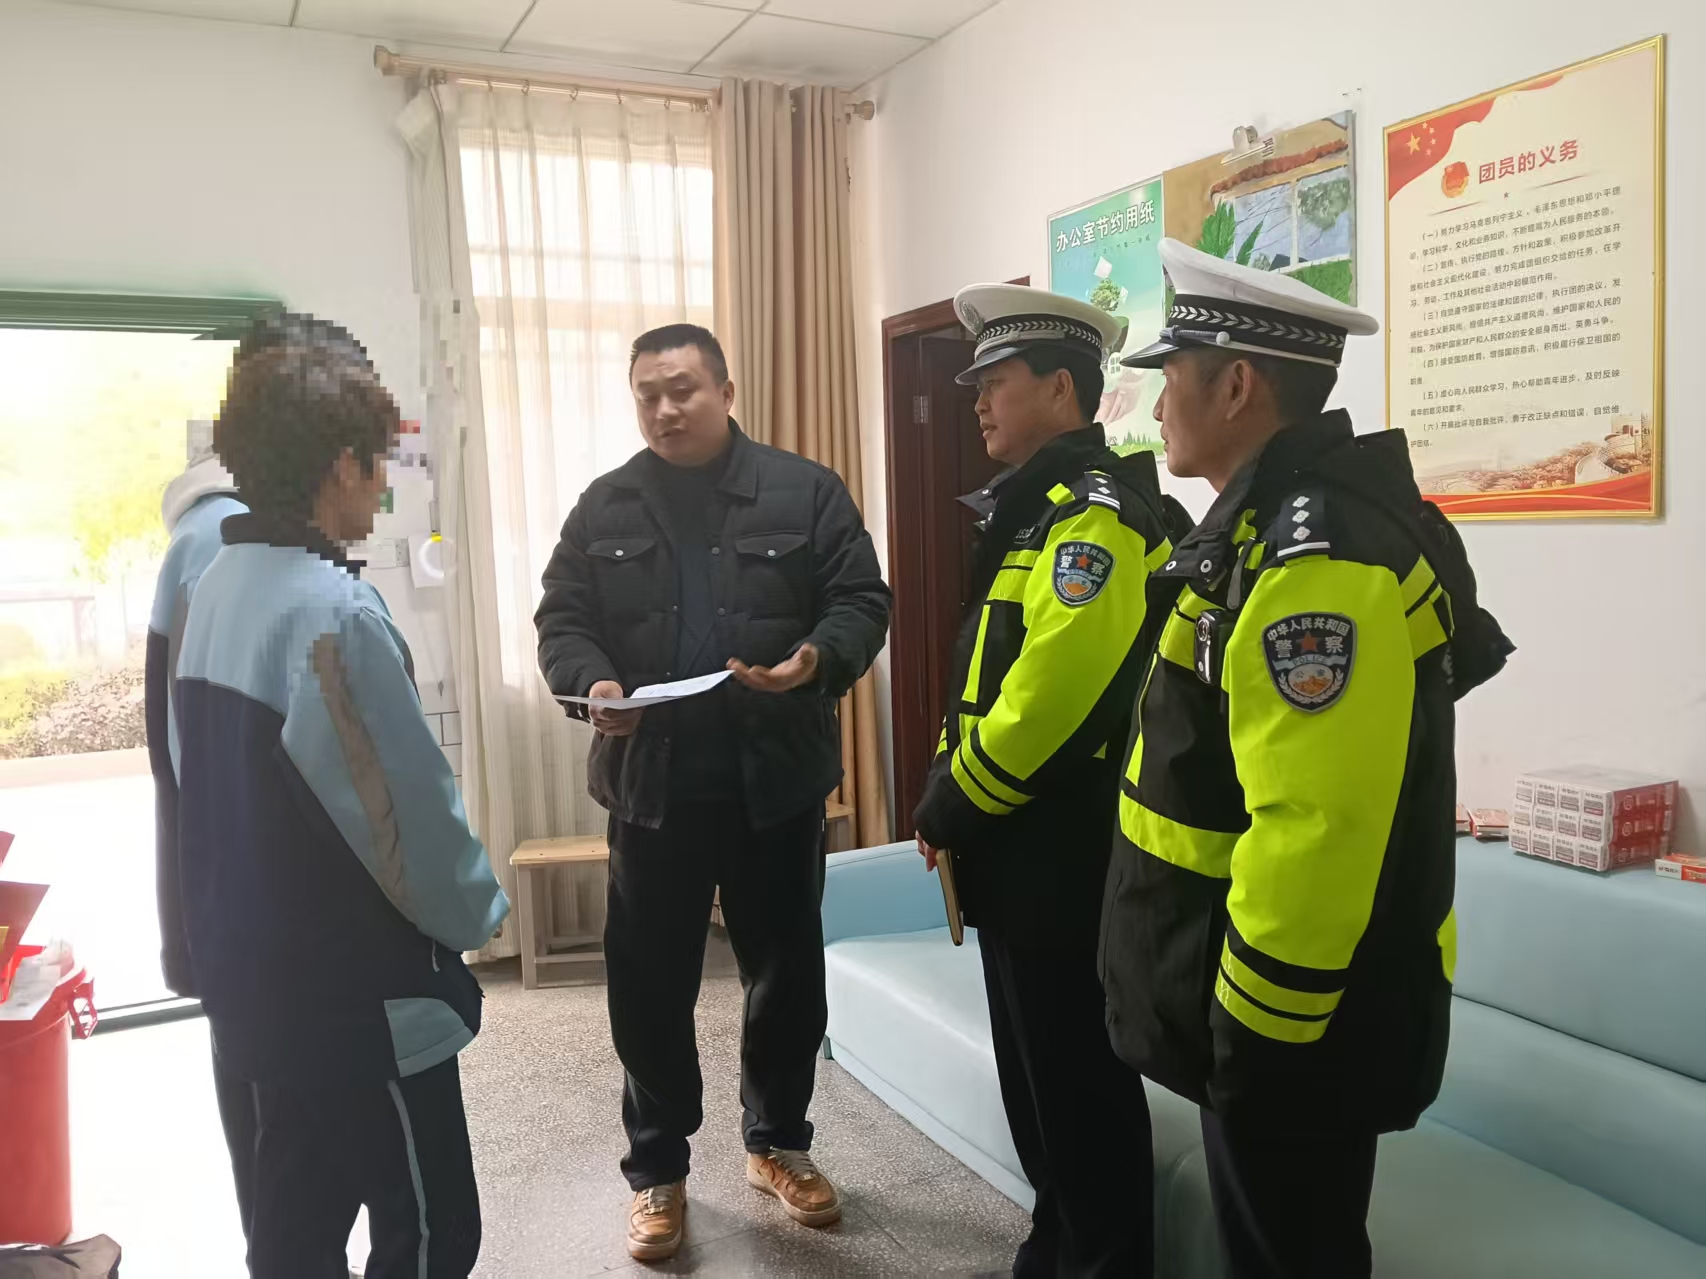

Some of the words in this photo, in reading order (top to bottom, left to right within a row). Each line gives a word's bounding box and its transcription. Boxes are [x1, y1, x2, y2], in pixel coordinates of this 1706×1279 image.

[1478, 139, 1579, 184] 团员的义务
[1056, 199, 1155, 253] 办公室节约用纸
[1266, 617, 1351, 641] 中华人民共和国
